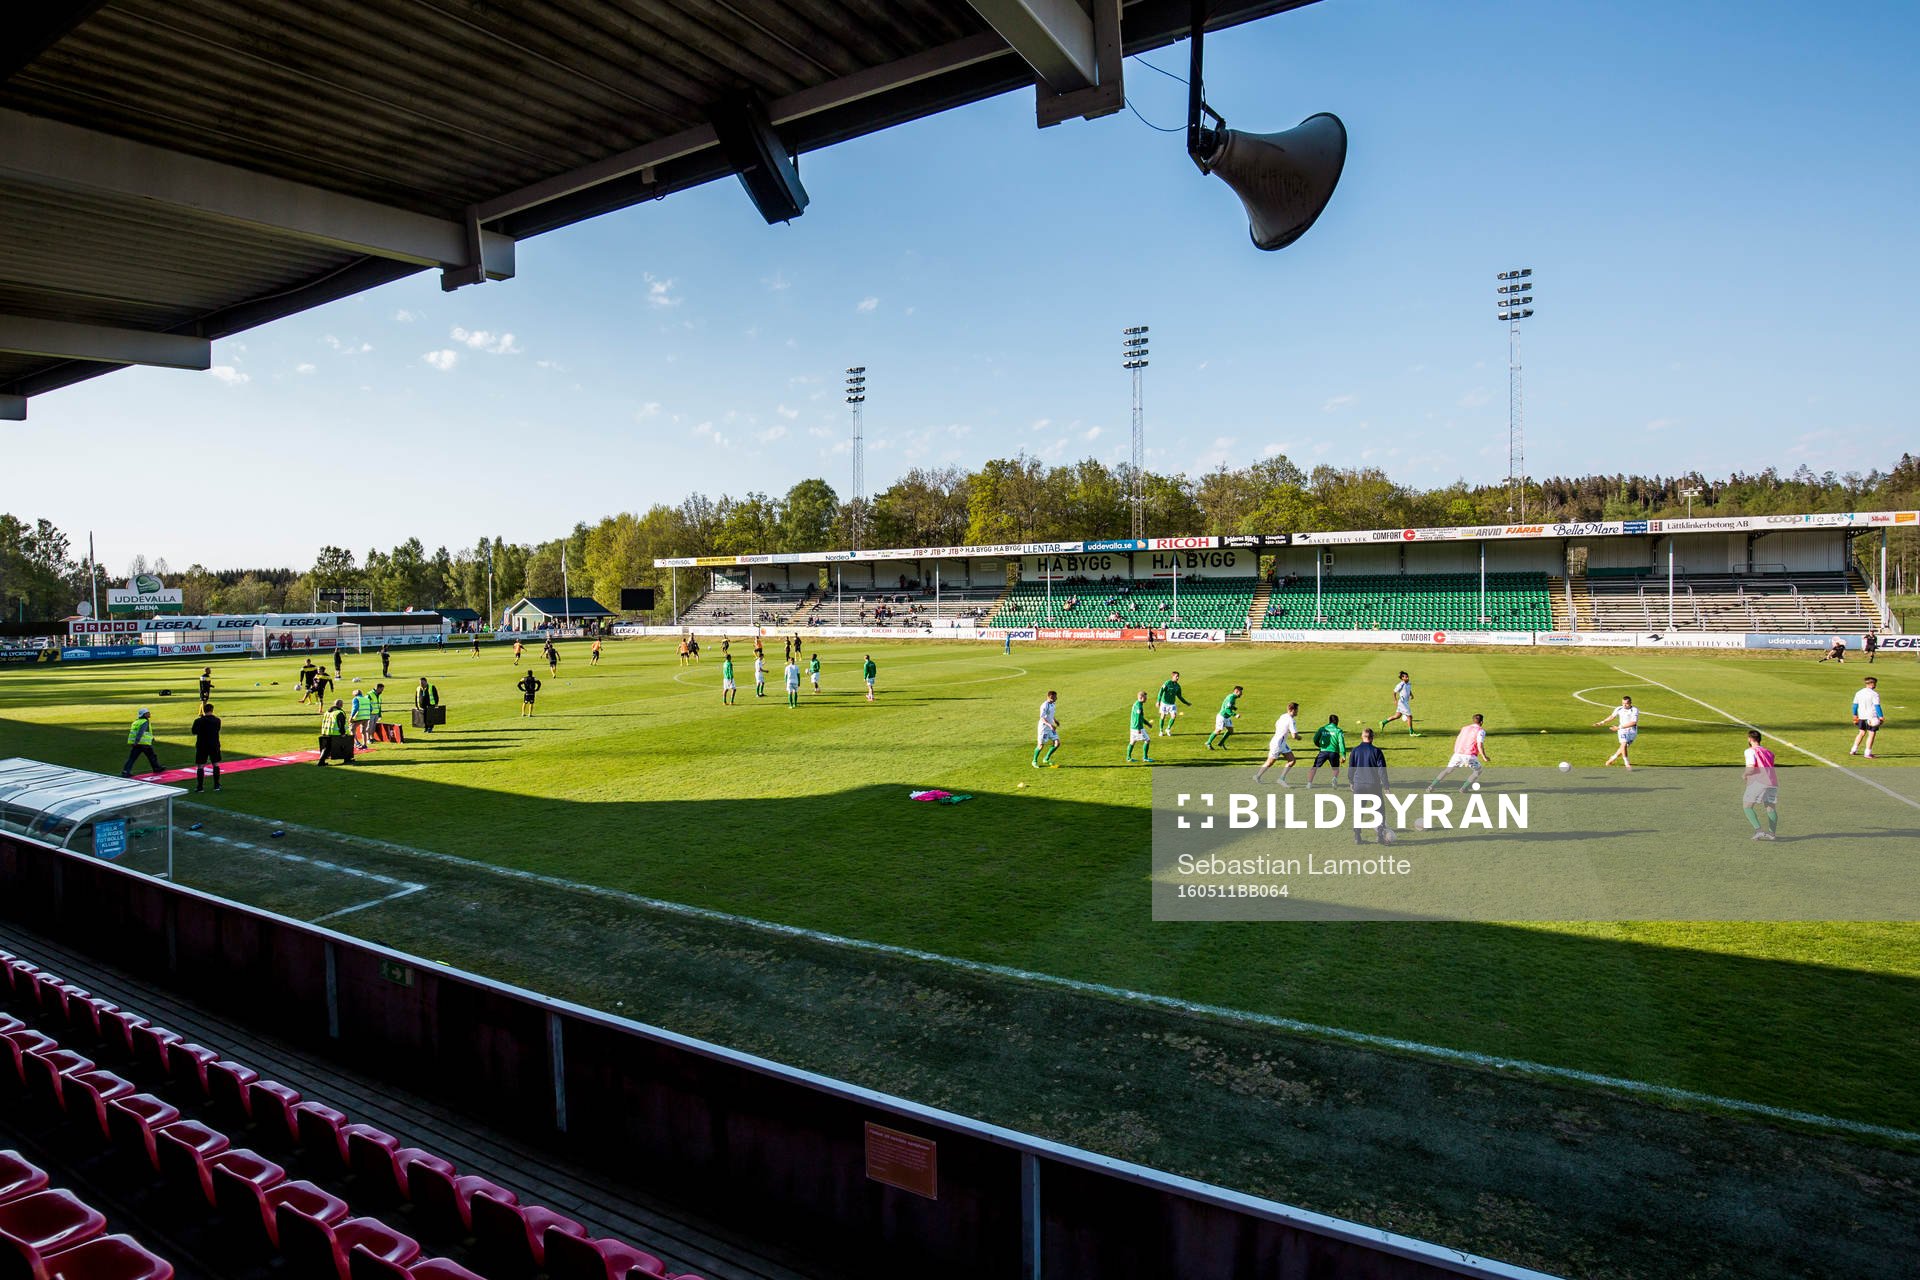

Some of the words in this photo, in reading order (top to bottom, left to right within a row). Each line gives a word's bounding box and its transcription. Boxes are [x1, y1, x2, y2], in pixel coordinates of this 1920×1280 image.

[1767, 516, 1803, 524] coop
[1552, 523, 1585, 536] Bella
[1586, 523, 1619, 535] Mare
[1667, 521, 1735, 530] Lättklinkerbetong
[1372, 532, 1401, 540] COMFORT
[1475, 527, 1502, 537] ARVID
[1087, 542, 1132, 551] uddevalla.se
[1156, 537, 1209, 549] RICOH
[912, 549, 924, 557] JTB
[929, 548, 941, 556] JTB
[948, 547, 959, 555] JTB
[1023, 543, 1061, 554] LLENTAB
[1037, 557, 1064, 572] H.A
[1067, 556, 1112, 571] BYGG
[1153, 554, 1182, 569] H.A
[1186, 552, 1236, 568] BYGG
[114, 595, 176, 603] UDDEVALLA
[74, 623, 136, 632] CRAMO
[1062, 629, 1072, 638] för
[1073, 629, 1095, 638] svensk
[1171, 631, 1215, 640] LEGEA
[1401, 633, 1431, 642] COMFORT
[1768, 637, 1824, 646] uddevalla.se
